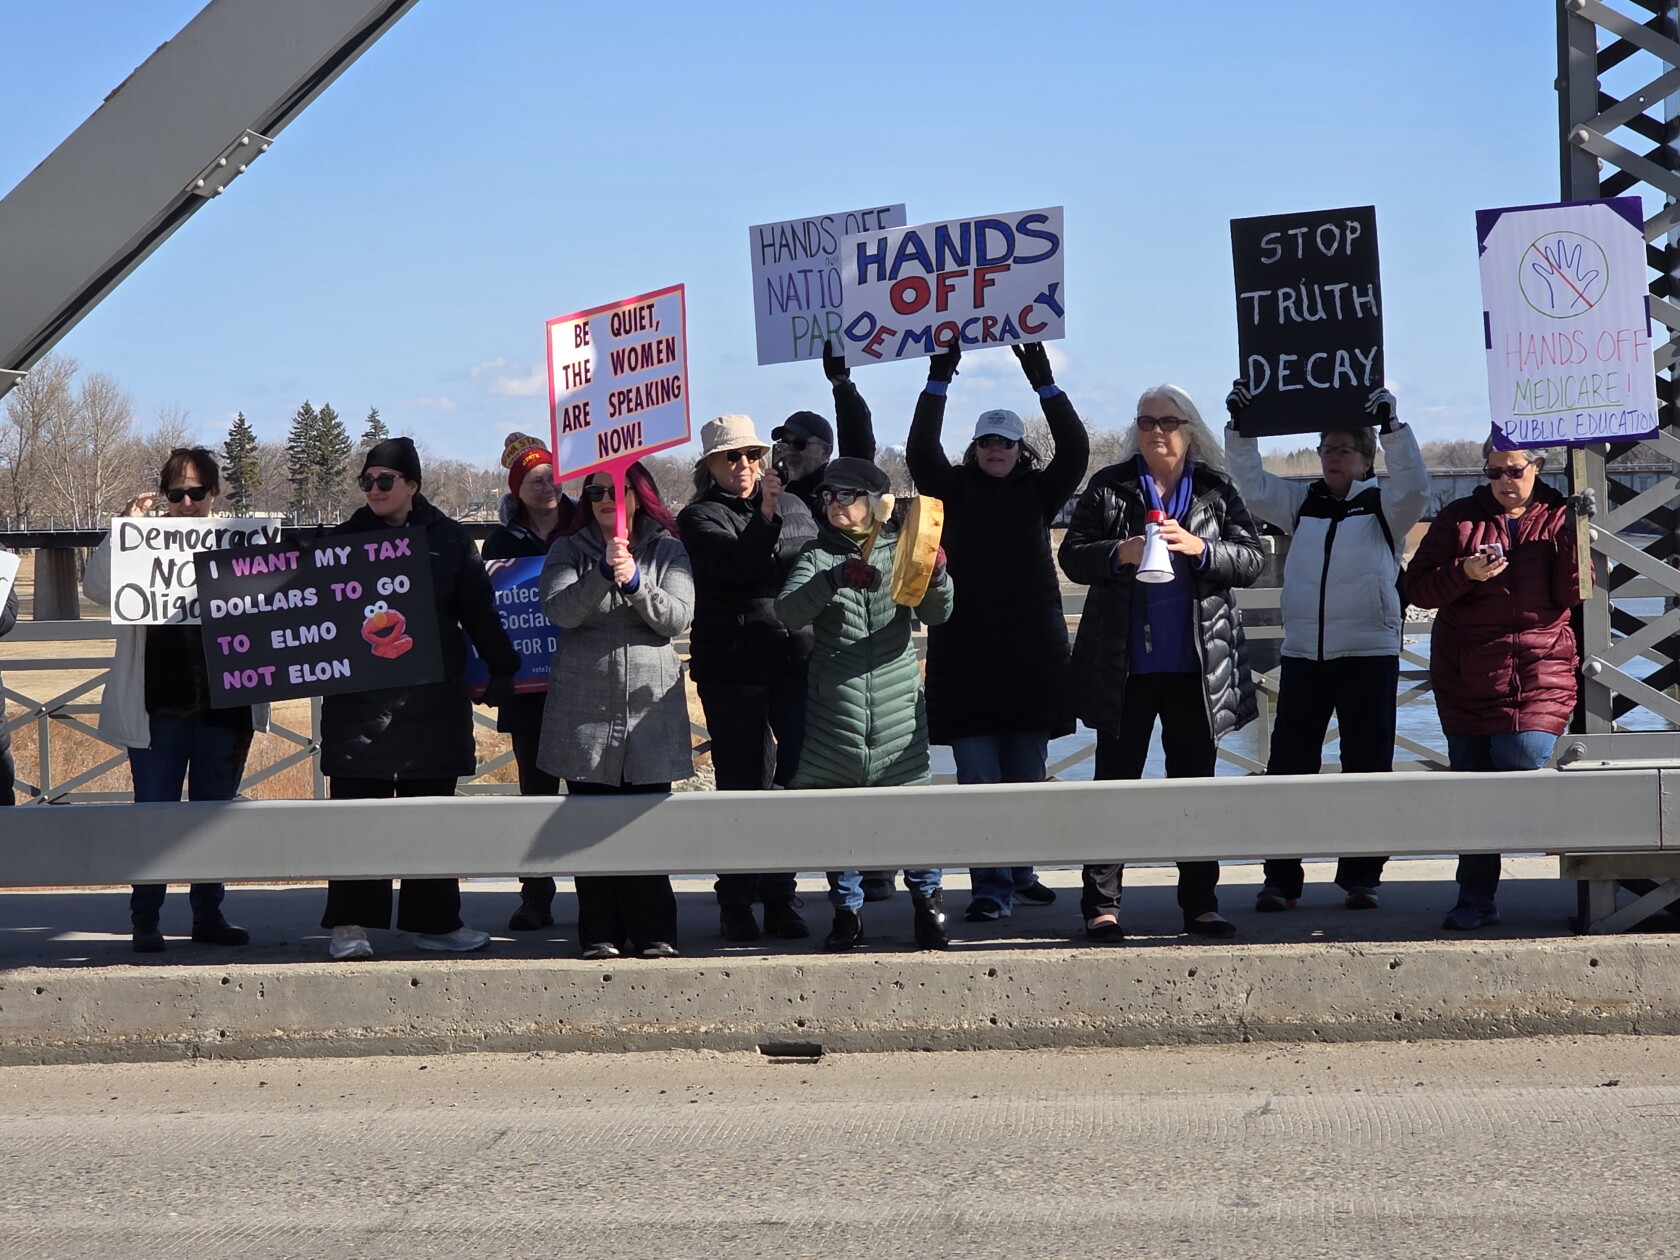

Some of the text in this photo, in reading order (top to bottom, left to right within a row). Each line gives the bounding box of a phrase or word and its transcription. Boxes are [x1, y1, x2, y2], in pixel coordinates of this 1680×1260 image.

[760, 216, 838, 266] HANDS
[857, 213, 1060, 286] HANDS
[1260, 220, 1361, 264] STOP
[767, 267, 843, 315] NATIO
[889, 264, 1012, 315] OFF
[1240, 280, 1379, 325] TRUTH
[574, 303, 661, 348] BE QUIET,
[792, 311, 845, 359] PAR
[844, 281, 1065, 359] DEMOCRACY
[562, 336, 676, 390] THE WOMEN
[1248, 346, 1378, 396] DECAY
[1506, 328, 1648, 372] HANDS OFF
[562, 375, 682, 434] ARE SPEAKING
[1505, 409, 1658, 440] PUBLIC EDUCATION
[598, 421, 642, 459] NOW!
[119, 521, 281, 552] Democracy
[209, 537, 412, 579] I WANT MY TAX
[210, 574, 410, 618] DOLLARS TO GO
[495, 585, 541, 606] rotec
[217, 621, 337, 655] TO ELMO
[513, 638, 543, 655] FOR
[223, 658, 351, 689] NOT ELON
